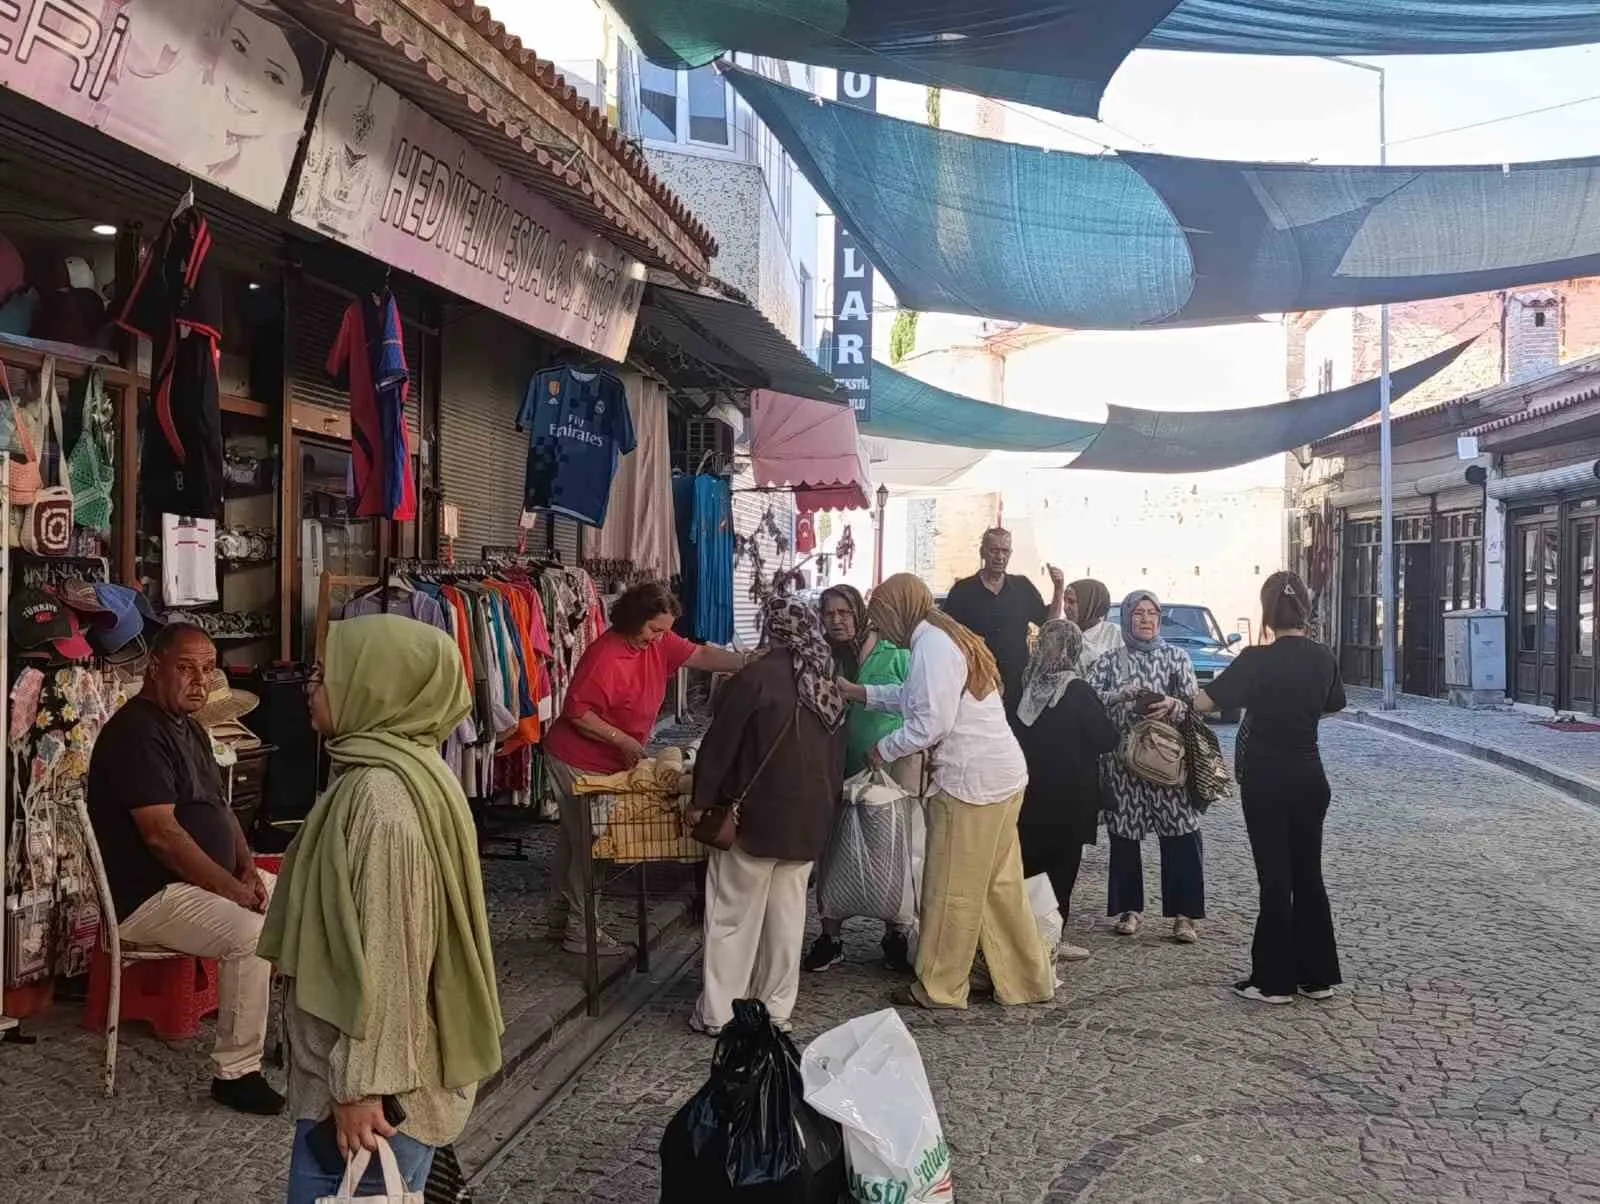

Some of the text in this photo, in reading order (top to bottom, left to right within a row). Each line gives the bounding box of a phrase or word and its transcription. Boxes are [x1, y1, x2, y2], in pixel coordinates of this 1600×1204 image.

[0, 0, 129, 101] Rİ
[497, 209, 551, 304] EŞYA
[544, 239, 568, 304] &
[837, 228, 869, 364] LAR
[834, 376, 870, 391] KSTİL
[549, 423, 603, 447] Emirates
[568, 413, 585, 427] Fly
